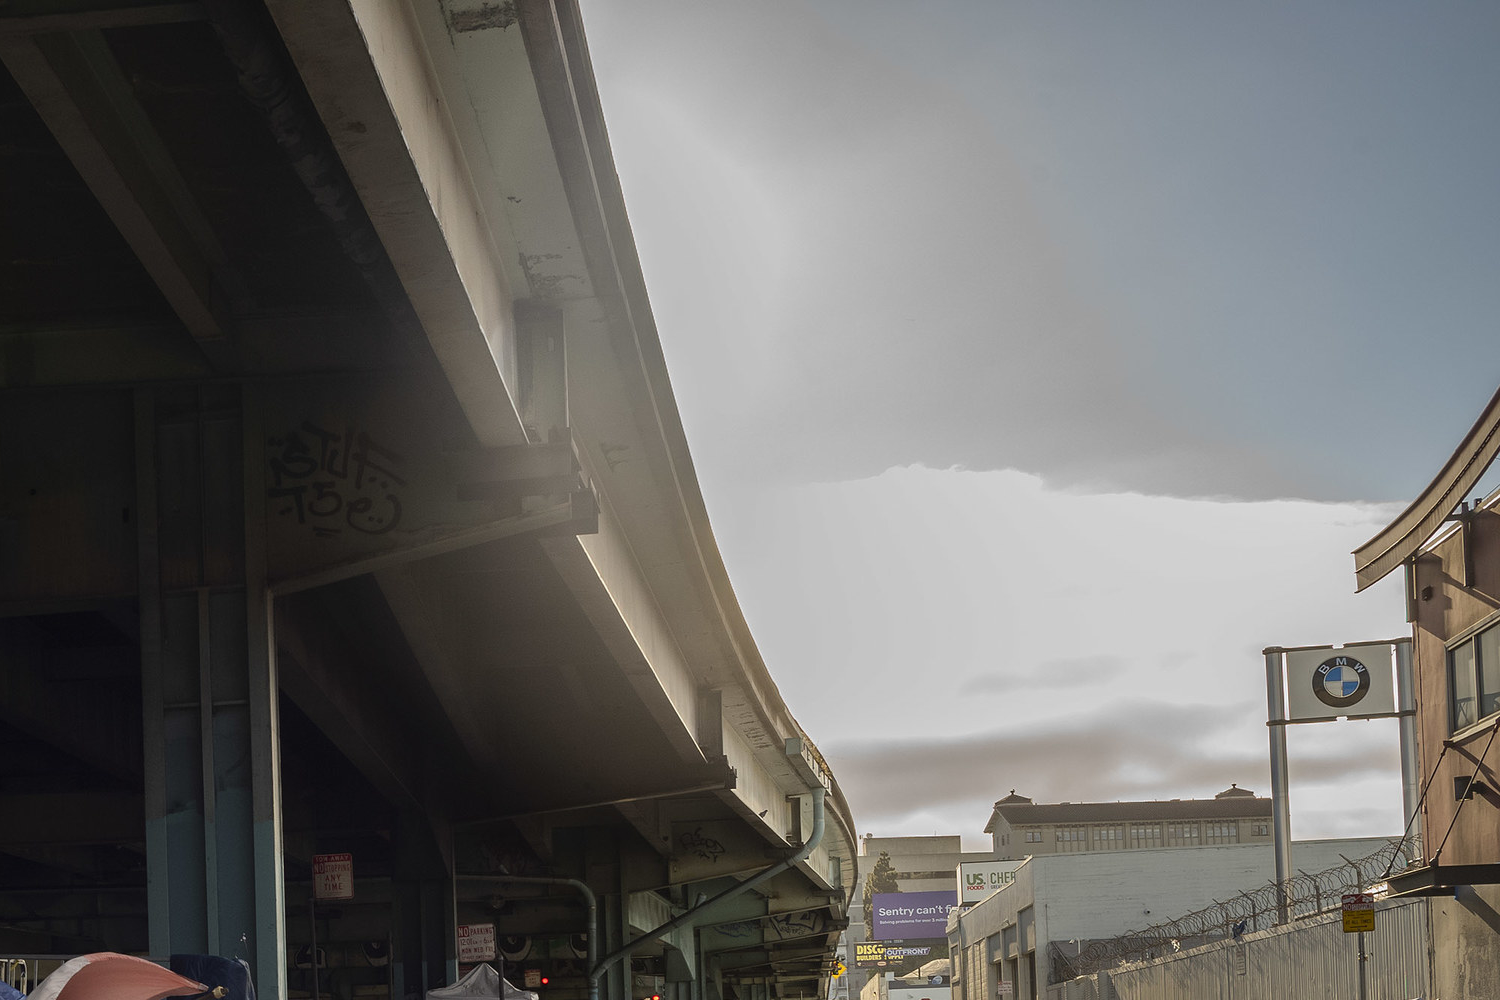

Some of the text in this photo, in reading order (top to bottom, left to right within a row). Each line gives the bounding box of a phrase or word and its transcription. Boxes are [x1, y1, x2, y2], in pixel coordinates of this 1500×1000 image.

[1318, 657, 1366, 675] BMW
[314, 863, 324, 874] NO
[324, 882, 343, 890] TIME
[878, 907, 915, 917] Sentry
[916, 905, 944, 915] can't
[458, 927, 493, 937] NO PARKING
[886, 948, 929, 956] OUTFRONT
